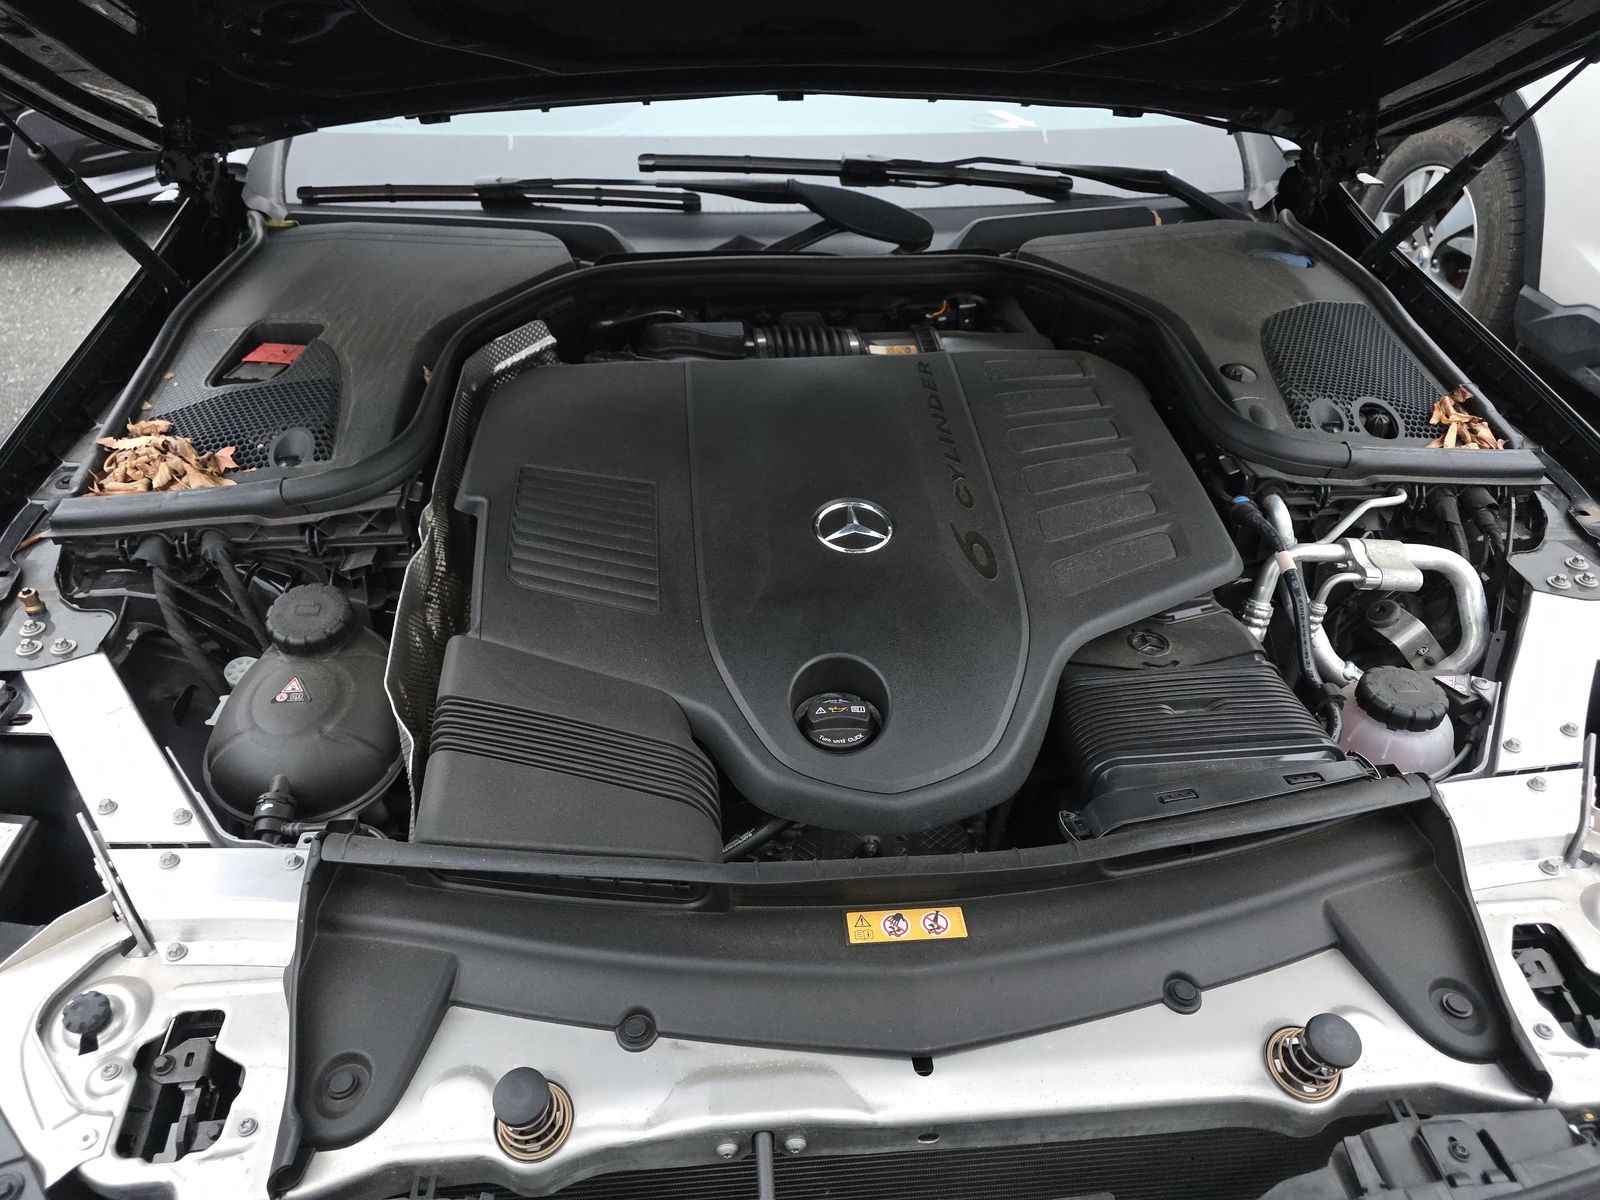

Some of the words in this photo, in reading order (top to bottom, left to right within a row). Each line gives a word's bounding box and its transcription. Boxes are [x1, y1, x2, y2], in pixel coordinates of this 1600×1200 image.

[918, 360, 975, 509] CYLINDER
[951, 521, 998, 580] 6
[818, 734, 832, 743] Turn
[847, 733, 865, 743] CLICK
